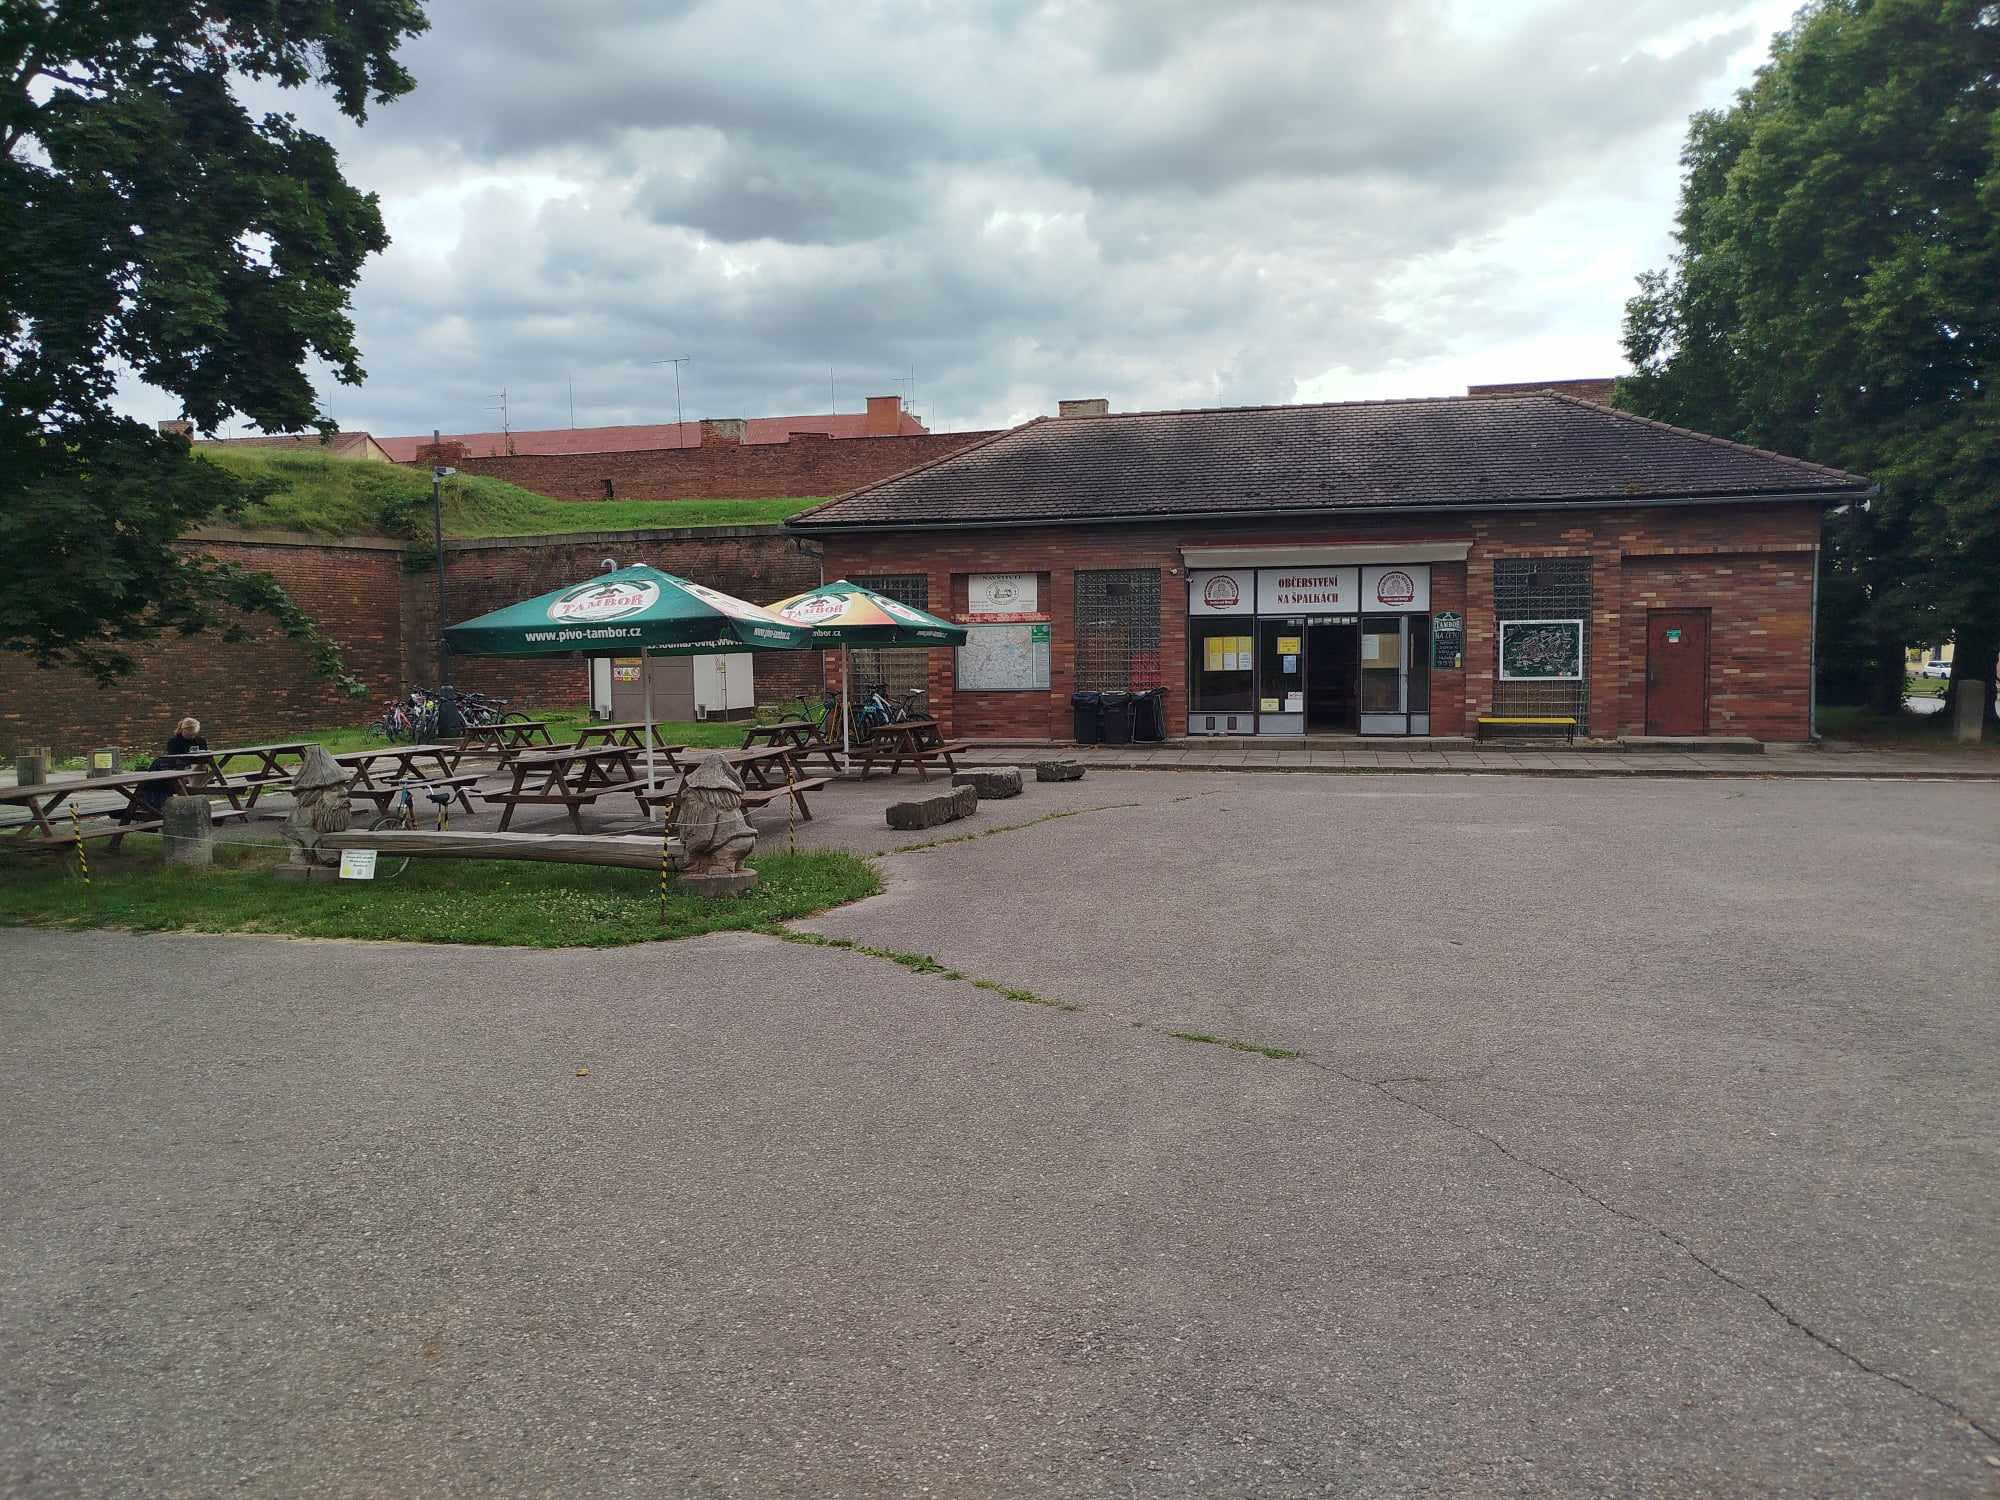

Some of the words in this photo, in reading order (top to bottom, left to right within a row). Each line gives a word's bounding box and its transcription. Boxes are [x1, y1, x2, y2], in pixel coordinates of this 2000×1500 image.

[1278, 574, 1338, 588] OBČERSTVENÍ
[562, 594, 643, 613] TAMBOR
[1278, 593, 1290, 604] NA
[1291, 591, 1339, 604] ŠPALKÁCH
[787, 603, 843, 616] TAMBOR
[525, 627, 641, 642] www.pivo-tambor.cz
